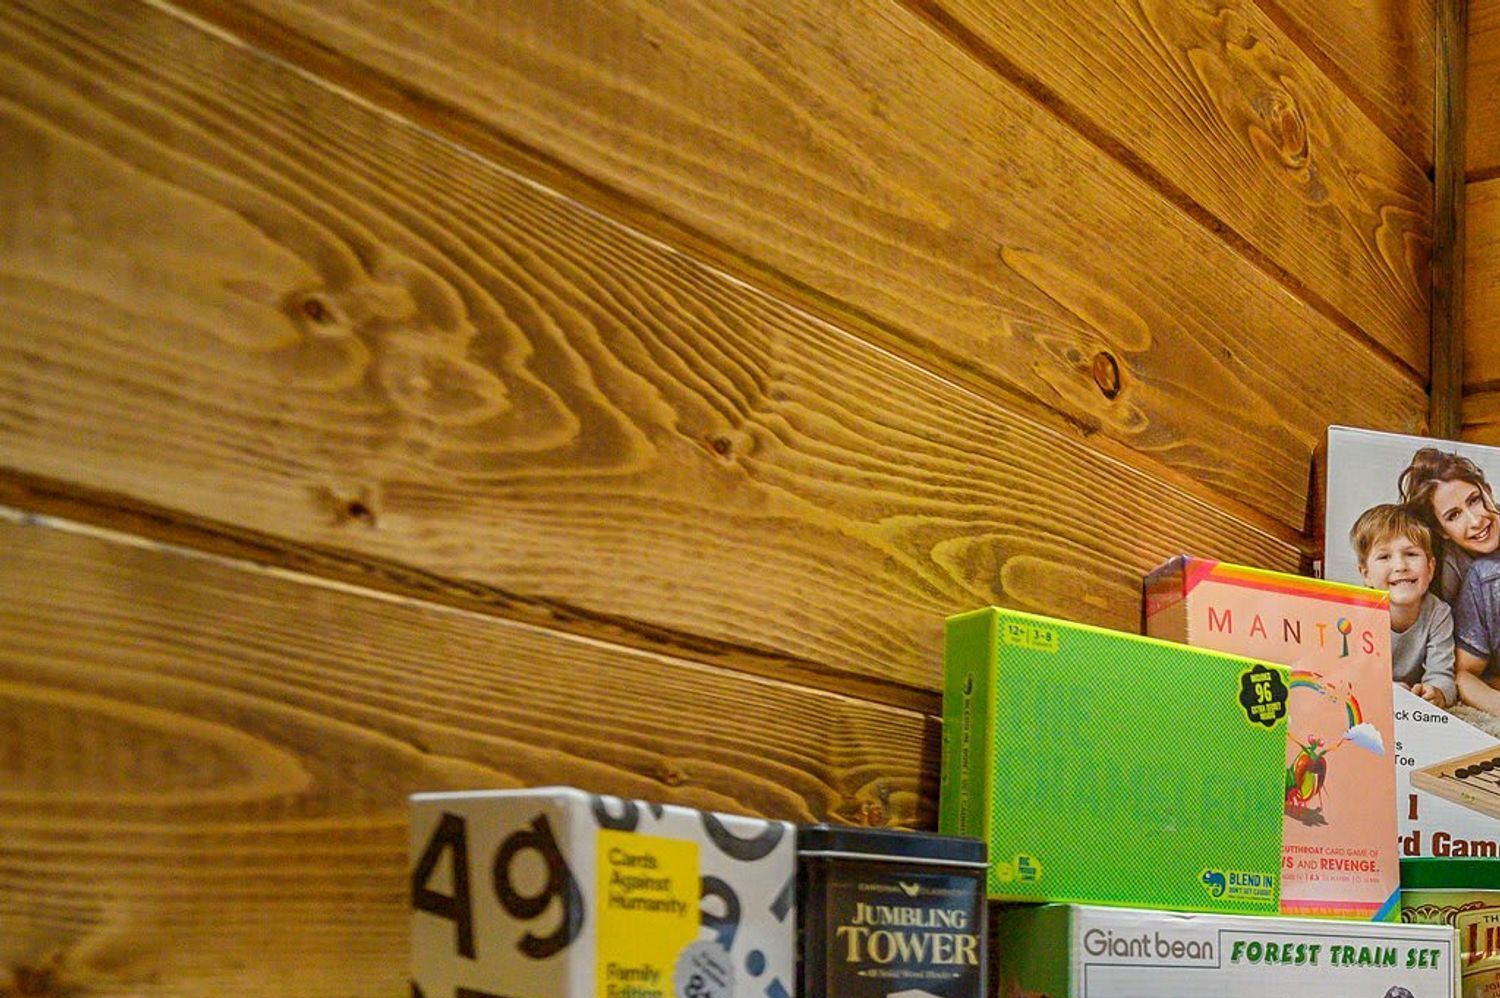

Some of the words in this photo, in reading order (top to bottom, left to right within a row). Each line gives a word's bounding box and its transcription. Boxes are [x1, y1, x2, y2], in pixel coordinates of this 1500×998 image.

[1207, 606, 1375, 658] MANTIS
[1255, 681, 1272, 703] 96
[1395, 710, 1409, 721] ck
[1412, 710, 1449, 724] Game
[1297, 860, 1318, 870] AND
[1320, 858, 1380, 873] REVENGE.
[1229, 872, 1261, 887] BLEND
[1263, 874, 1273, 888] IN
[852, 902, 969, 929] JUMBLING
[836, 926, 979, 966] TOWER
[1230, 939, 1320, 965] FOREST
[1330, 943, 1398, 968] TRAIN
[1405, 947, 1442, 970] SET
